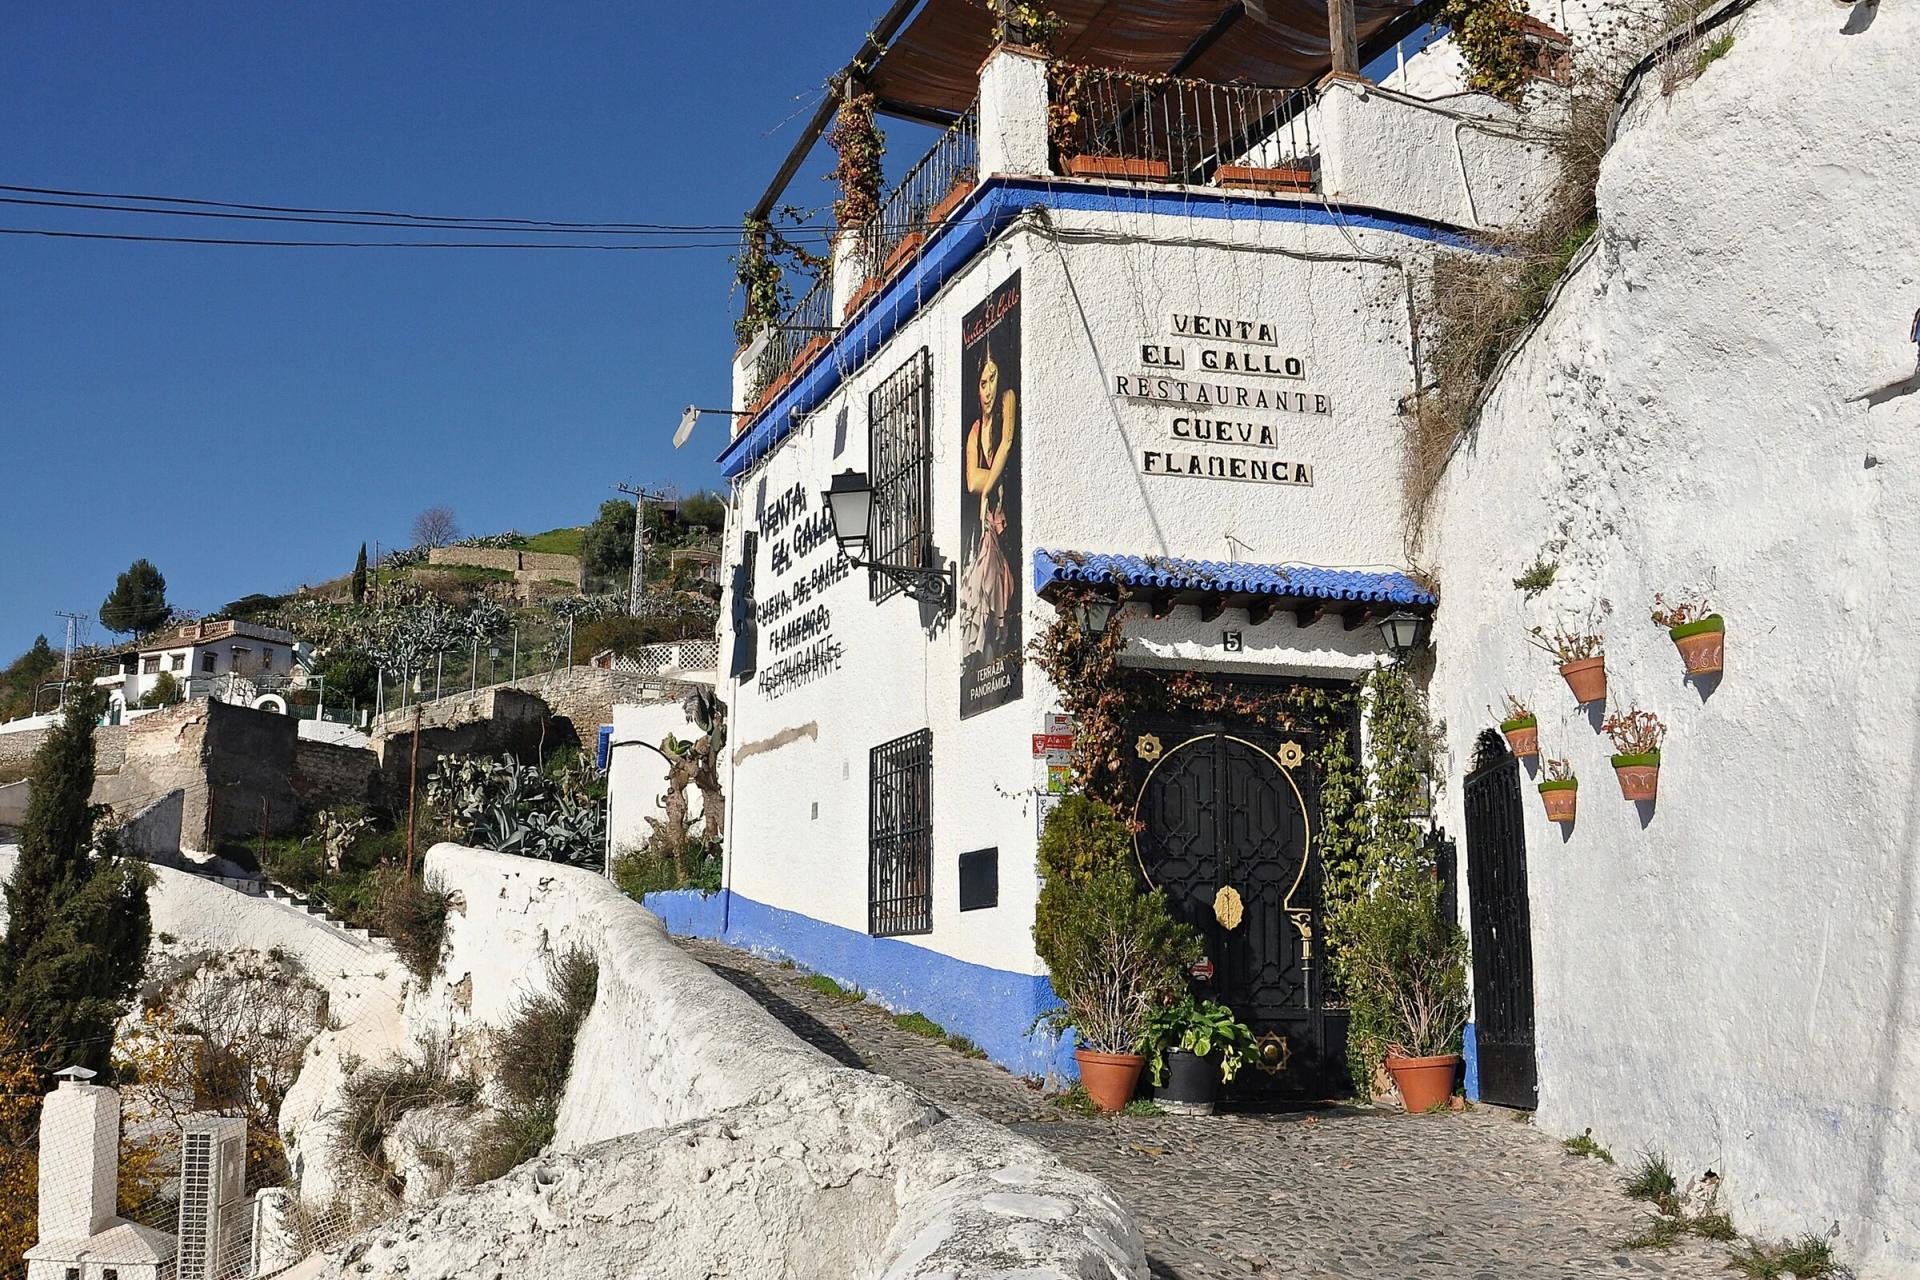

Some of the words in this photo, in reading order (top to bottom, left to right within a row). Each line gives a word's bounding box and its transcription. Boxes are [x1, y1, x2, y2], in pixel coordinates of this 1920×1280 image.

[1172, 314, 1273, 342] VENTA
[1142, 345, 1181, 366] EL
[1201, 350, 1301, 376] GALLO
[1116, 376, 1328, 414] RESTAURANTE
[1172, 417, 1274, 445] CUEVA
[1144, 451, 1310, 483] FLAMENCA
[759, 482, 805, 538] VENTA
[772, 538, 789, 573] EL
[793, 507, 835, 553] GALL
[757, 589, 787, 623] CUEVA
[793, 576, 806, 601] DE
[812, 551, 844, 589] BAILE
[770, 604, 825, 651] FLAMENCO
[1226, 632, 1239, 651] 5
[758, 634, 836, 696] RESTAURANTE
[977, 660, 1005, 682] TERRAZA
